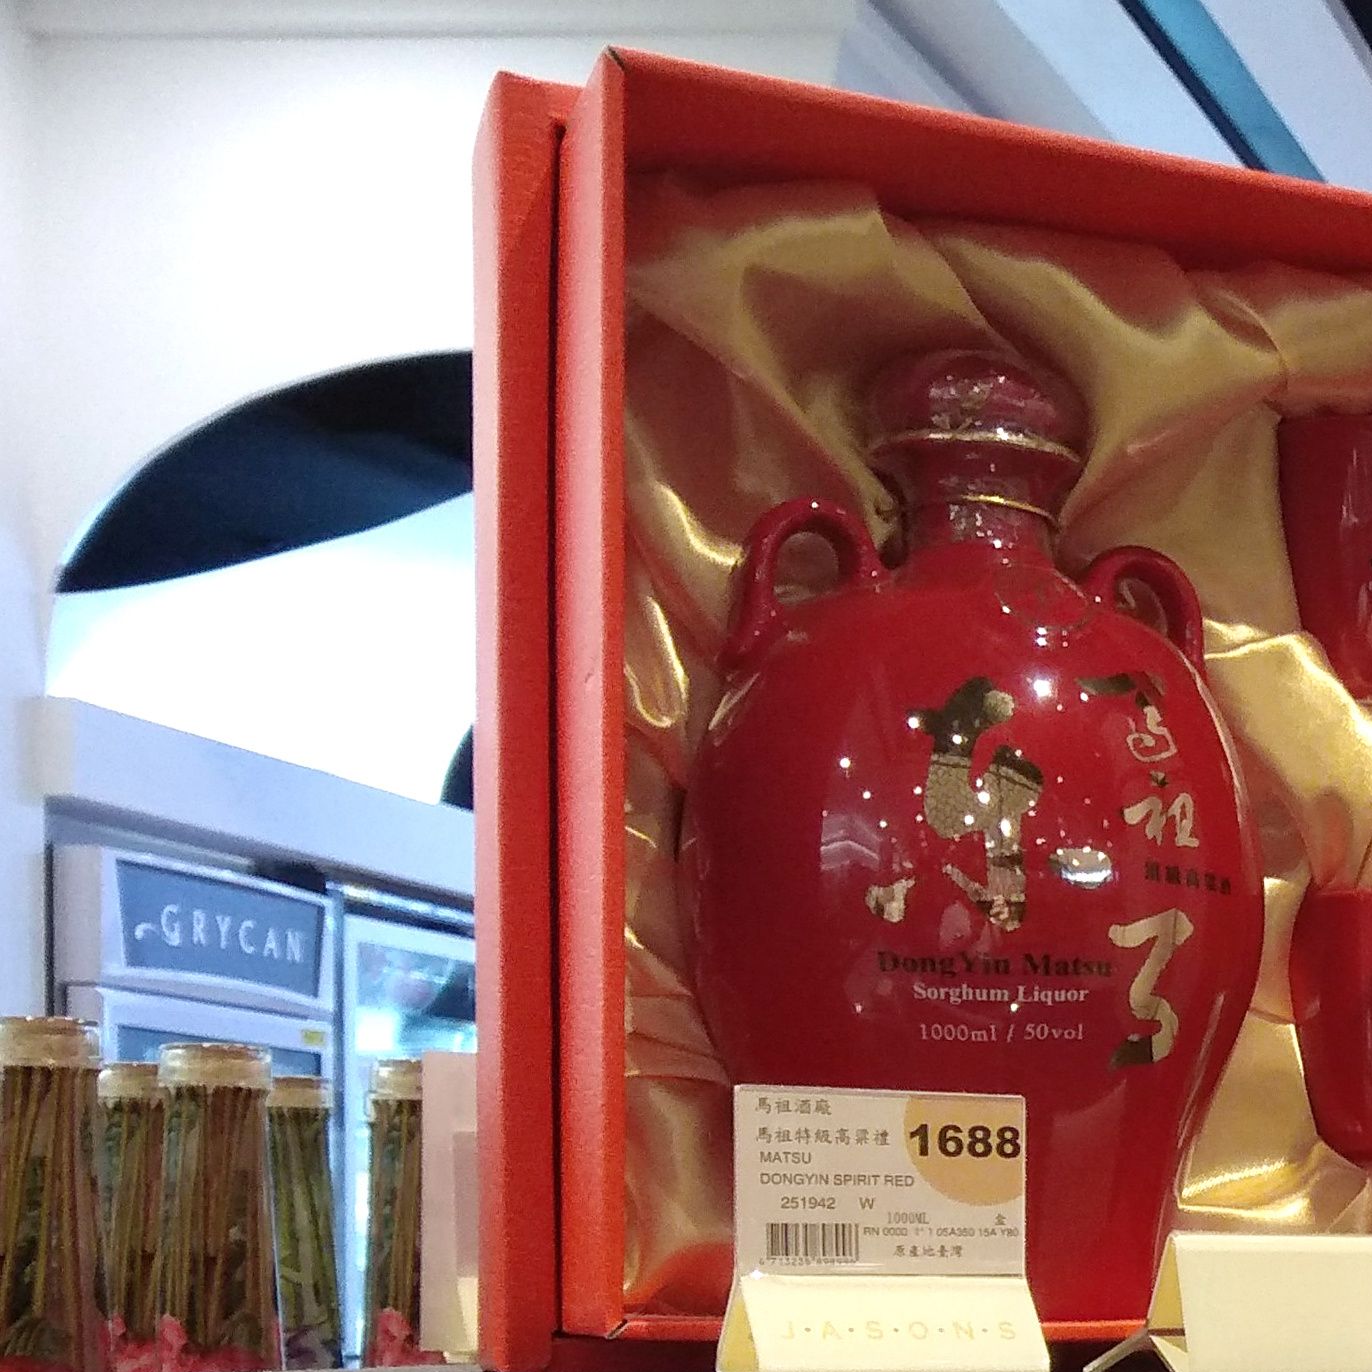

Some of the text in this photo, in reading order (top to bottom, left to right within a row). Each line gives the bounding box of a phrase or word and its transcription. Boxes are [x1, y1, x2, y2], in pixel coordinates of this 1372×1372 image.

[160, 903, 303, 962] GRYCAN
[1021, 951, 1114, 978] Matsu
[913, 983, 1090, 1007] Sorghum Liquor
[919, 1023, 998, 1043] 1000ml
[1023, 1023, 1085, 1042] 50vol
[909, 1123, 1021, 1158] 1688
[759, 1151, 812, 1165] MATSU
[760, 1173, 915, 1188] DONGYIN SPIRIT RED
[780, 1197, 875, 1210] 251942 W
